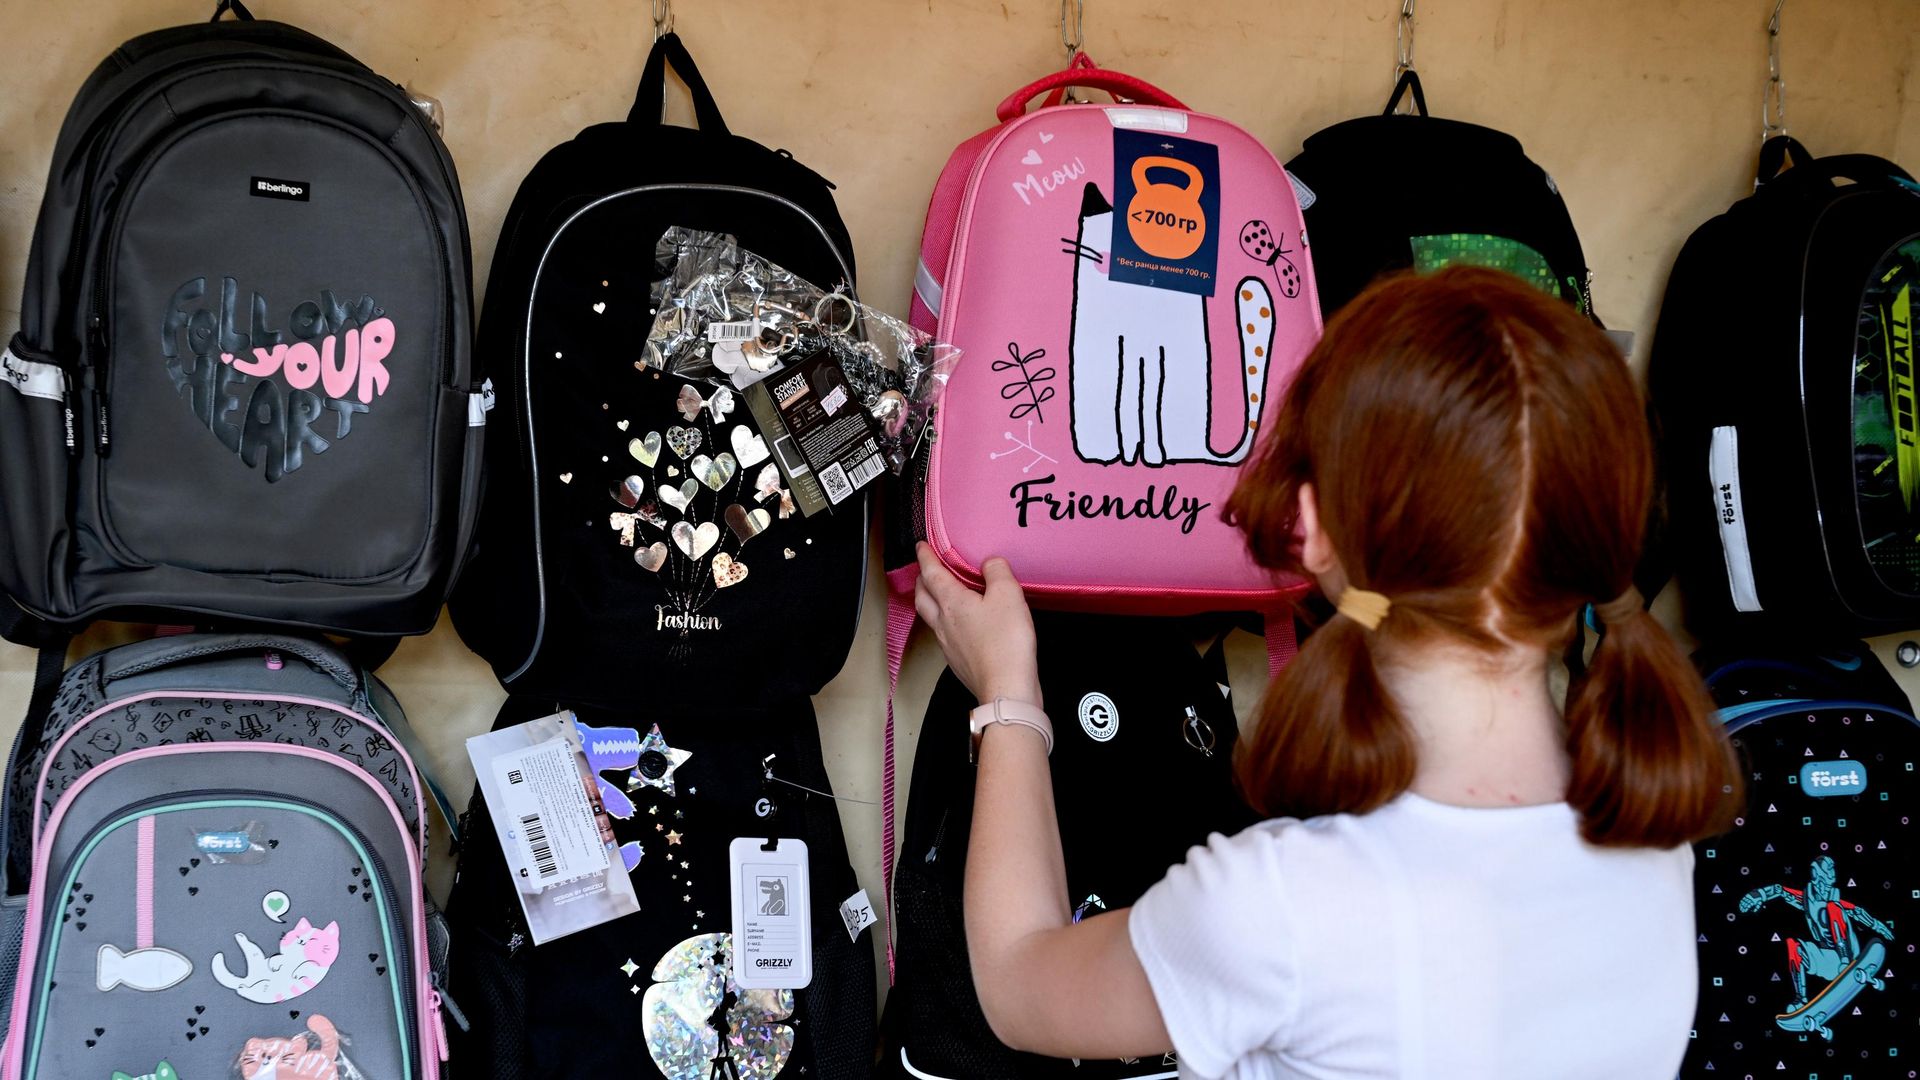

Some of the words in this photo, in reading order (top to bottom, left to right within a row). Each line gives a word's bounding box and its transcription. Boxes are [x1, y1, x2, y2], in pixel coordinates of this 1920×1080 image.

[266, 182, 303, 196] berlingo
[1012, 156, 1085, 205] Meow
[1178, 216, 1198, 233] гр
[1135, 261, 1158, 270] ранца
[1160, 265, 1184, 274] менее
[1186, 268, 1199, 276] 700
[1200, 272, 1210, 280] гр.
[233, 318, 396, 404] YOUR
[774, 372, 804, 396] COMFORT
[777, 379, 808, 402] STANDART
[1892, 316, 1914, 447] FOOTBALL
[65, 408, 74, 439] berlingo
[166, 356, 370, 484] HEART
[1010, 474, 1211, 534] Friendly
[1720, 484, 1736, 524] först
[655, 604, 722, 630] Fashion
[1090, 726, 1112, 736] GRIZZLY
[1811, 770, 1860, 787] först
[754, 798, 770, 817] G
[756, 958, 792, 967] GRIZZLY
